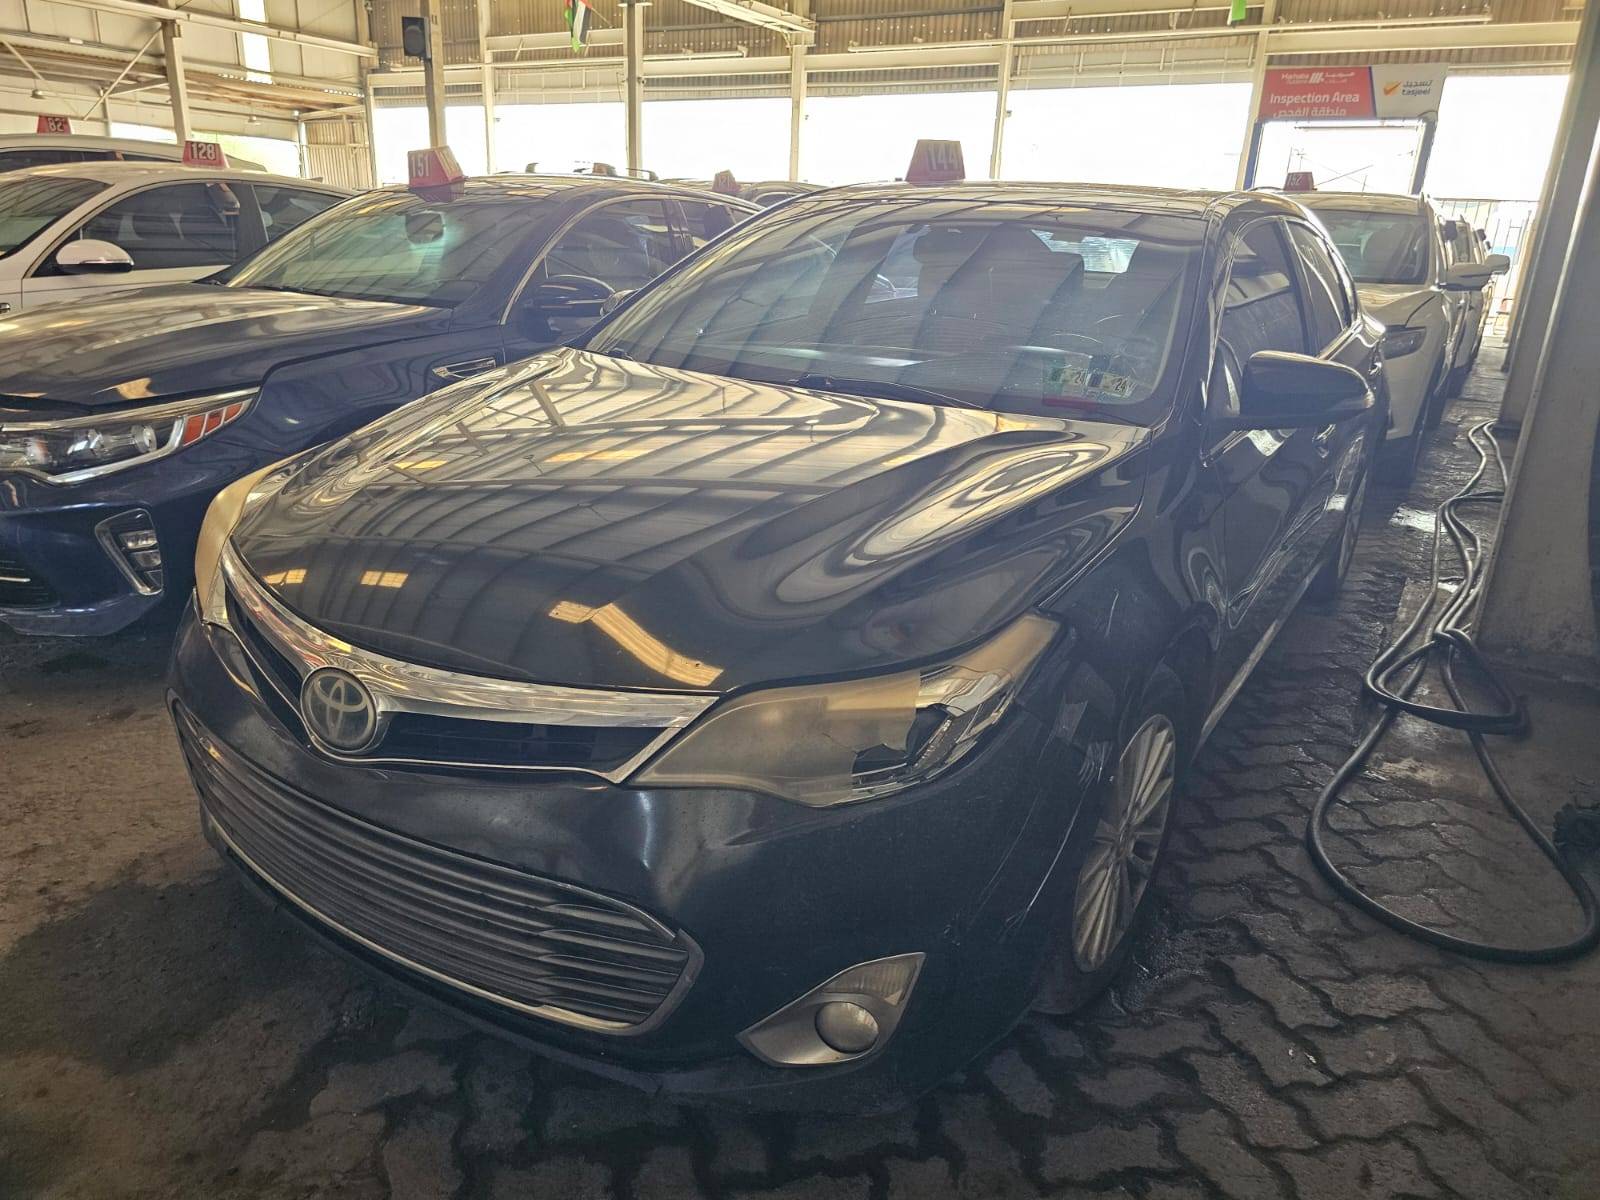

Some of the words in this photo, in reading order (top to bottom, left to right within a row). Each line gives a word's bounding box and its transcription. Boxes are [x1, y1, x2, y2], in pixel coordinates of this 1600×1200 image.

[1270, 92, 1329, 106] Inspection
[1332, 92, 1360, 102] Area
[191, 143, 216, 160] 128
[411, 154, 430, 177] 151
